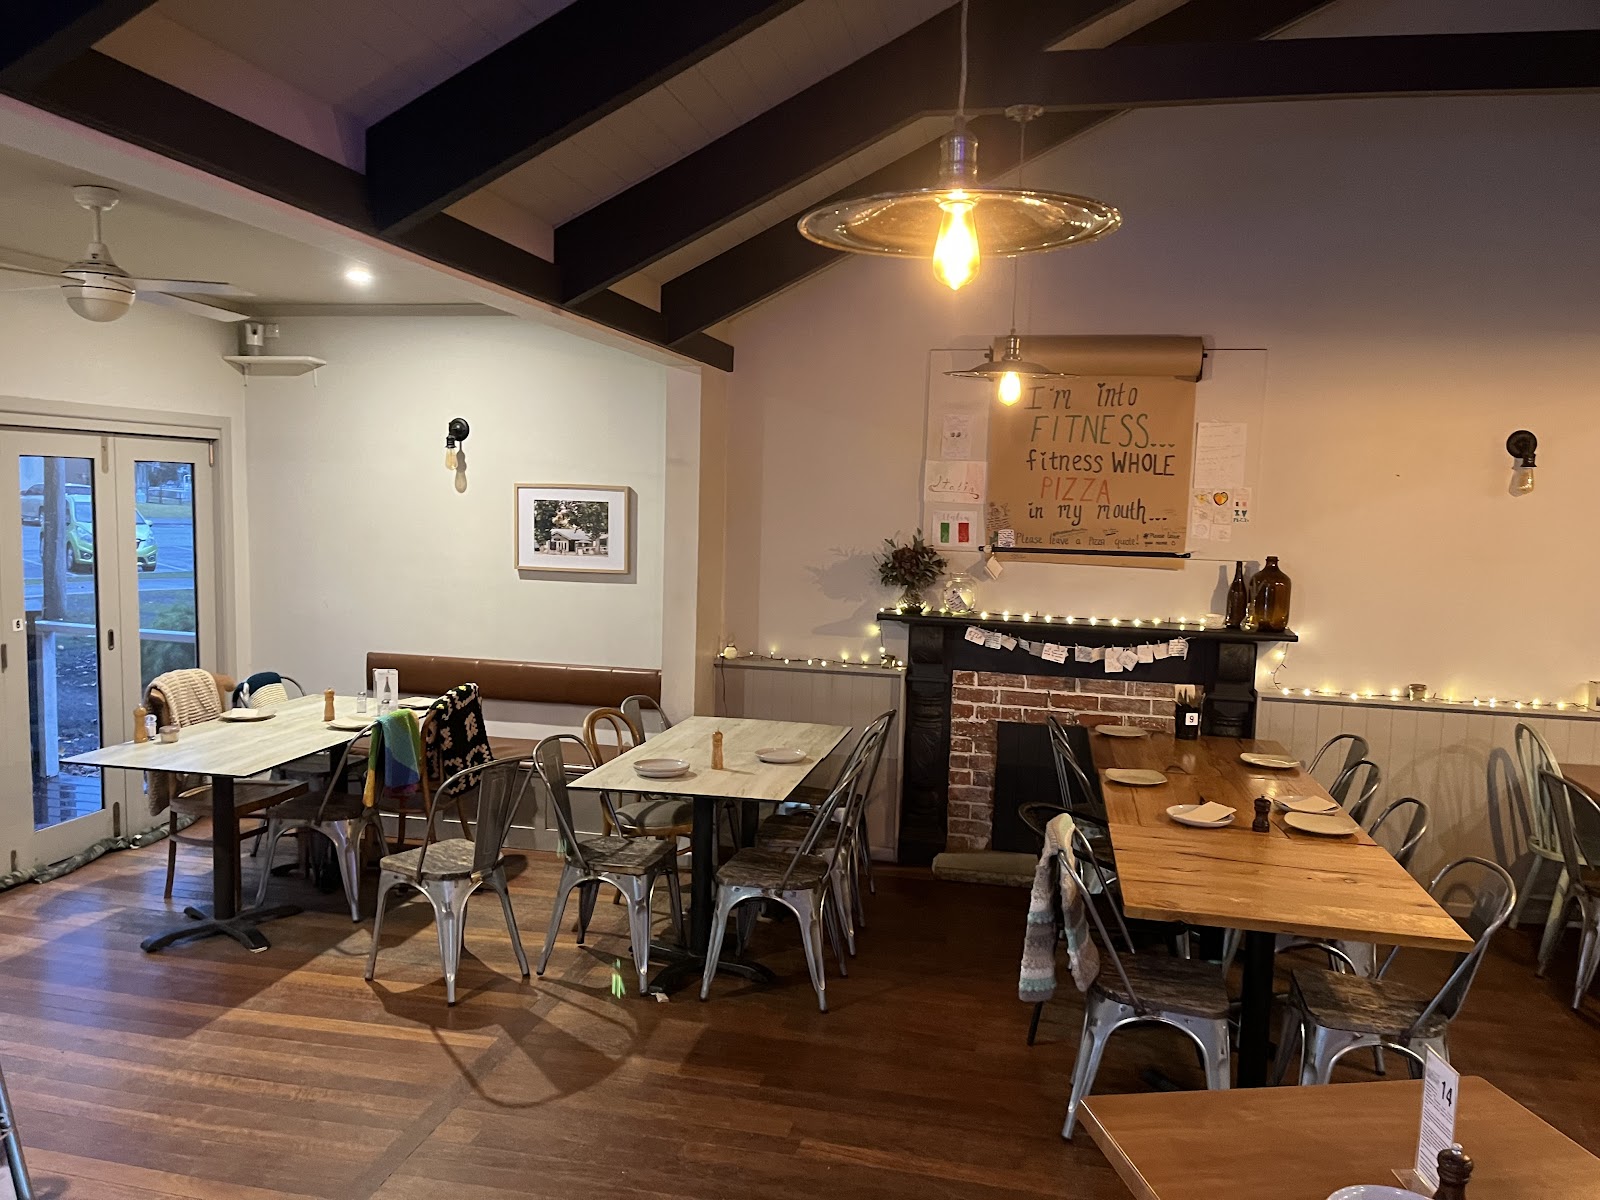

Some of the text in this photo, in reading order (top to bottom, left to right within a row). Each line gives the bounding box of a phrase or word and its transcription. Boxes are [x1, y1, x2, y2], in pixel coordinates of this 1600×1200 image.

[1024, 382, 1139, 410] I'm into
[1030, 413, 1176, 449] FITNESS...
[1026, 449, 1176, 477] fitness WHOLE
[1040, 476, 1111, 505] PIZZA
[1027, 498, 1168, 527] in my mouth...
[1014, 532, 1043, 545] Please
[1189, 715, 1195, 724] 9
[1441, 1081, 1453, 1107] 14
